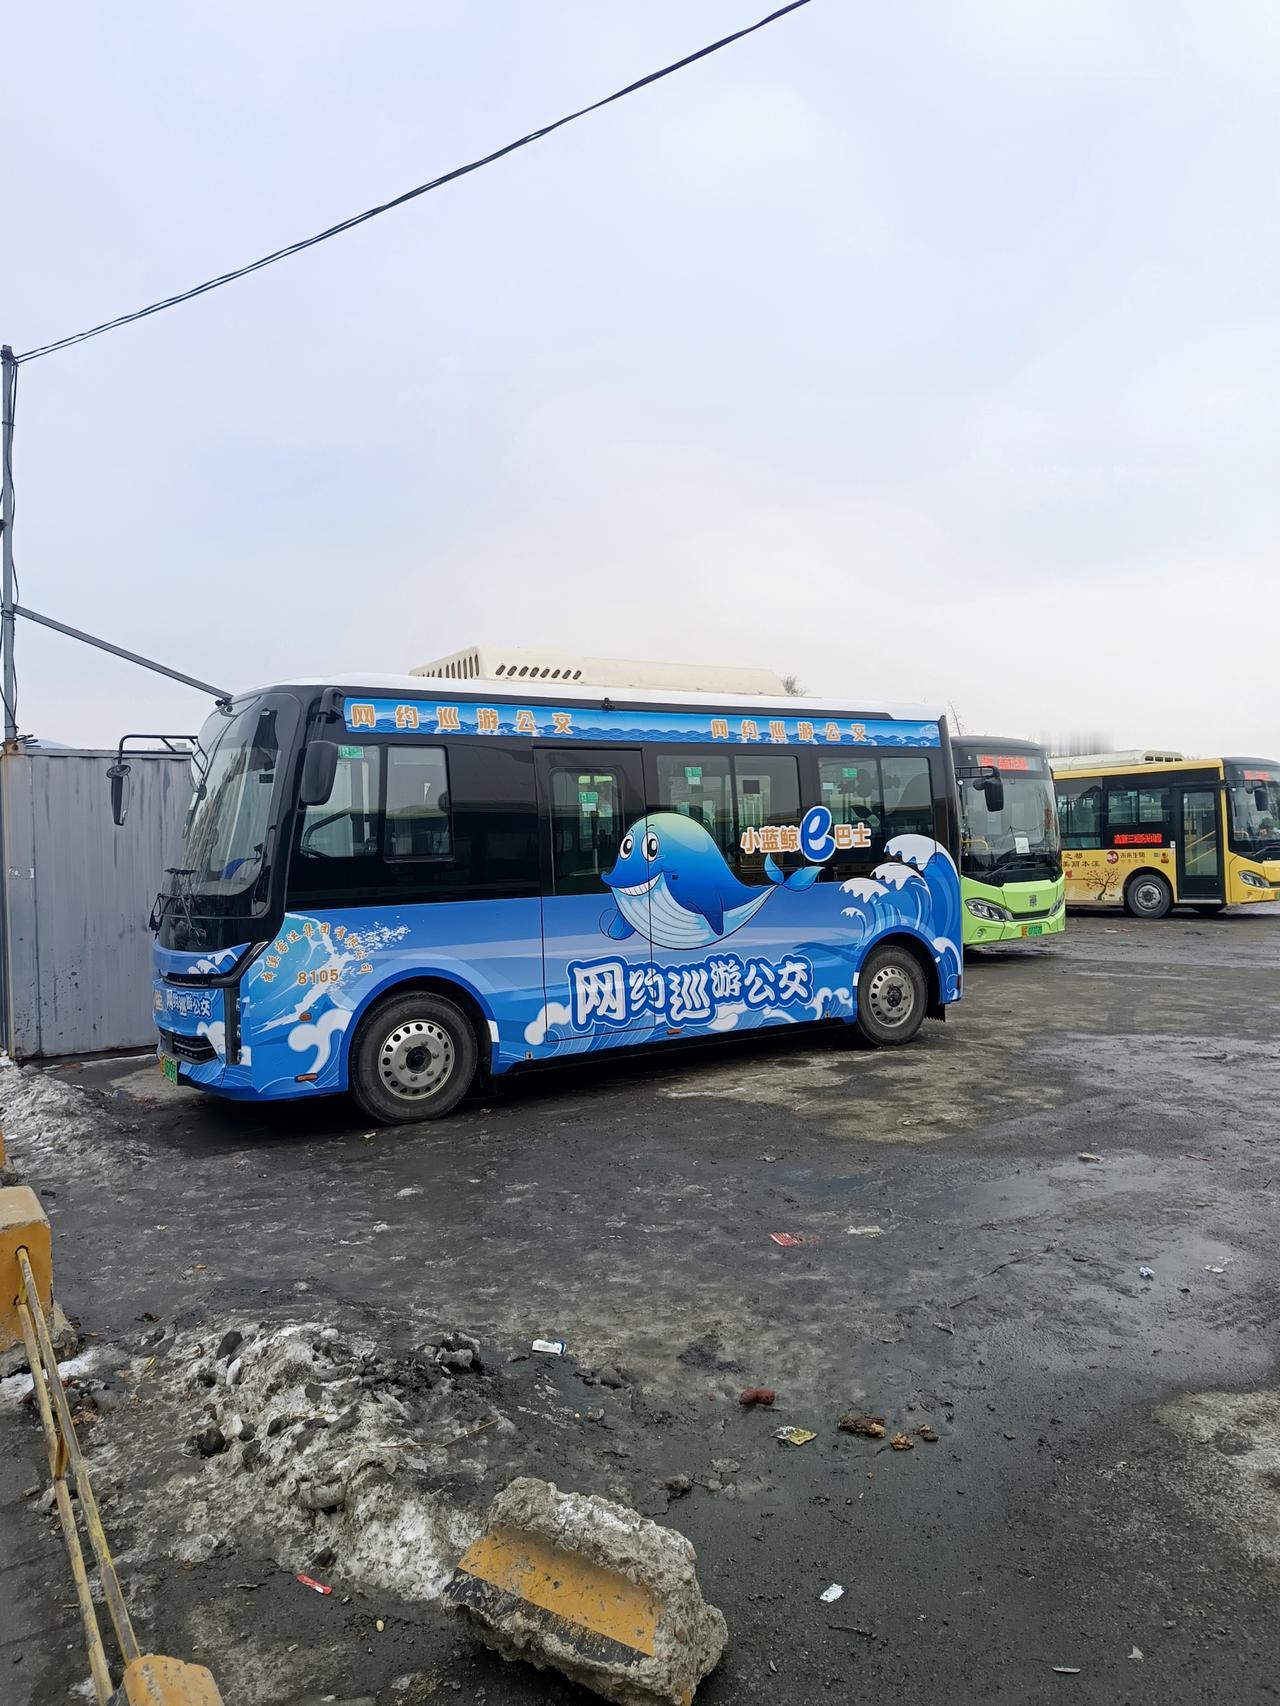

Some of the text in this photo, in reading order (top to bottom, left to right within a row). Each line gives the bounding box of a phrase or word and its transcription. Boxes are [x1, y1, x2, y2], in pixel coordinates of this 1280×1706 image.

[350, 703, 574, 735] 网约巡游公交
[710, 718, 867, 742] 网约巡游公交
[297, 968, 340, 986] 8105
[572, 956, 808, 1025] 网约巡游公交
